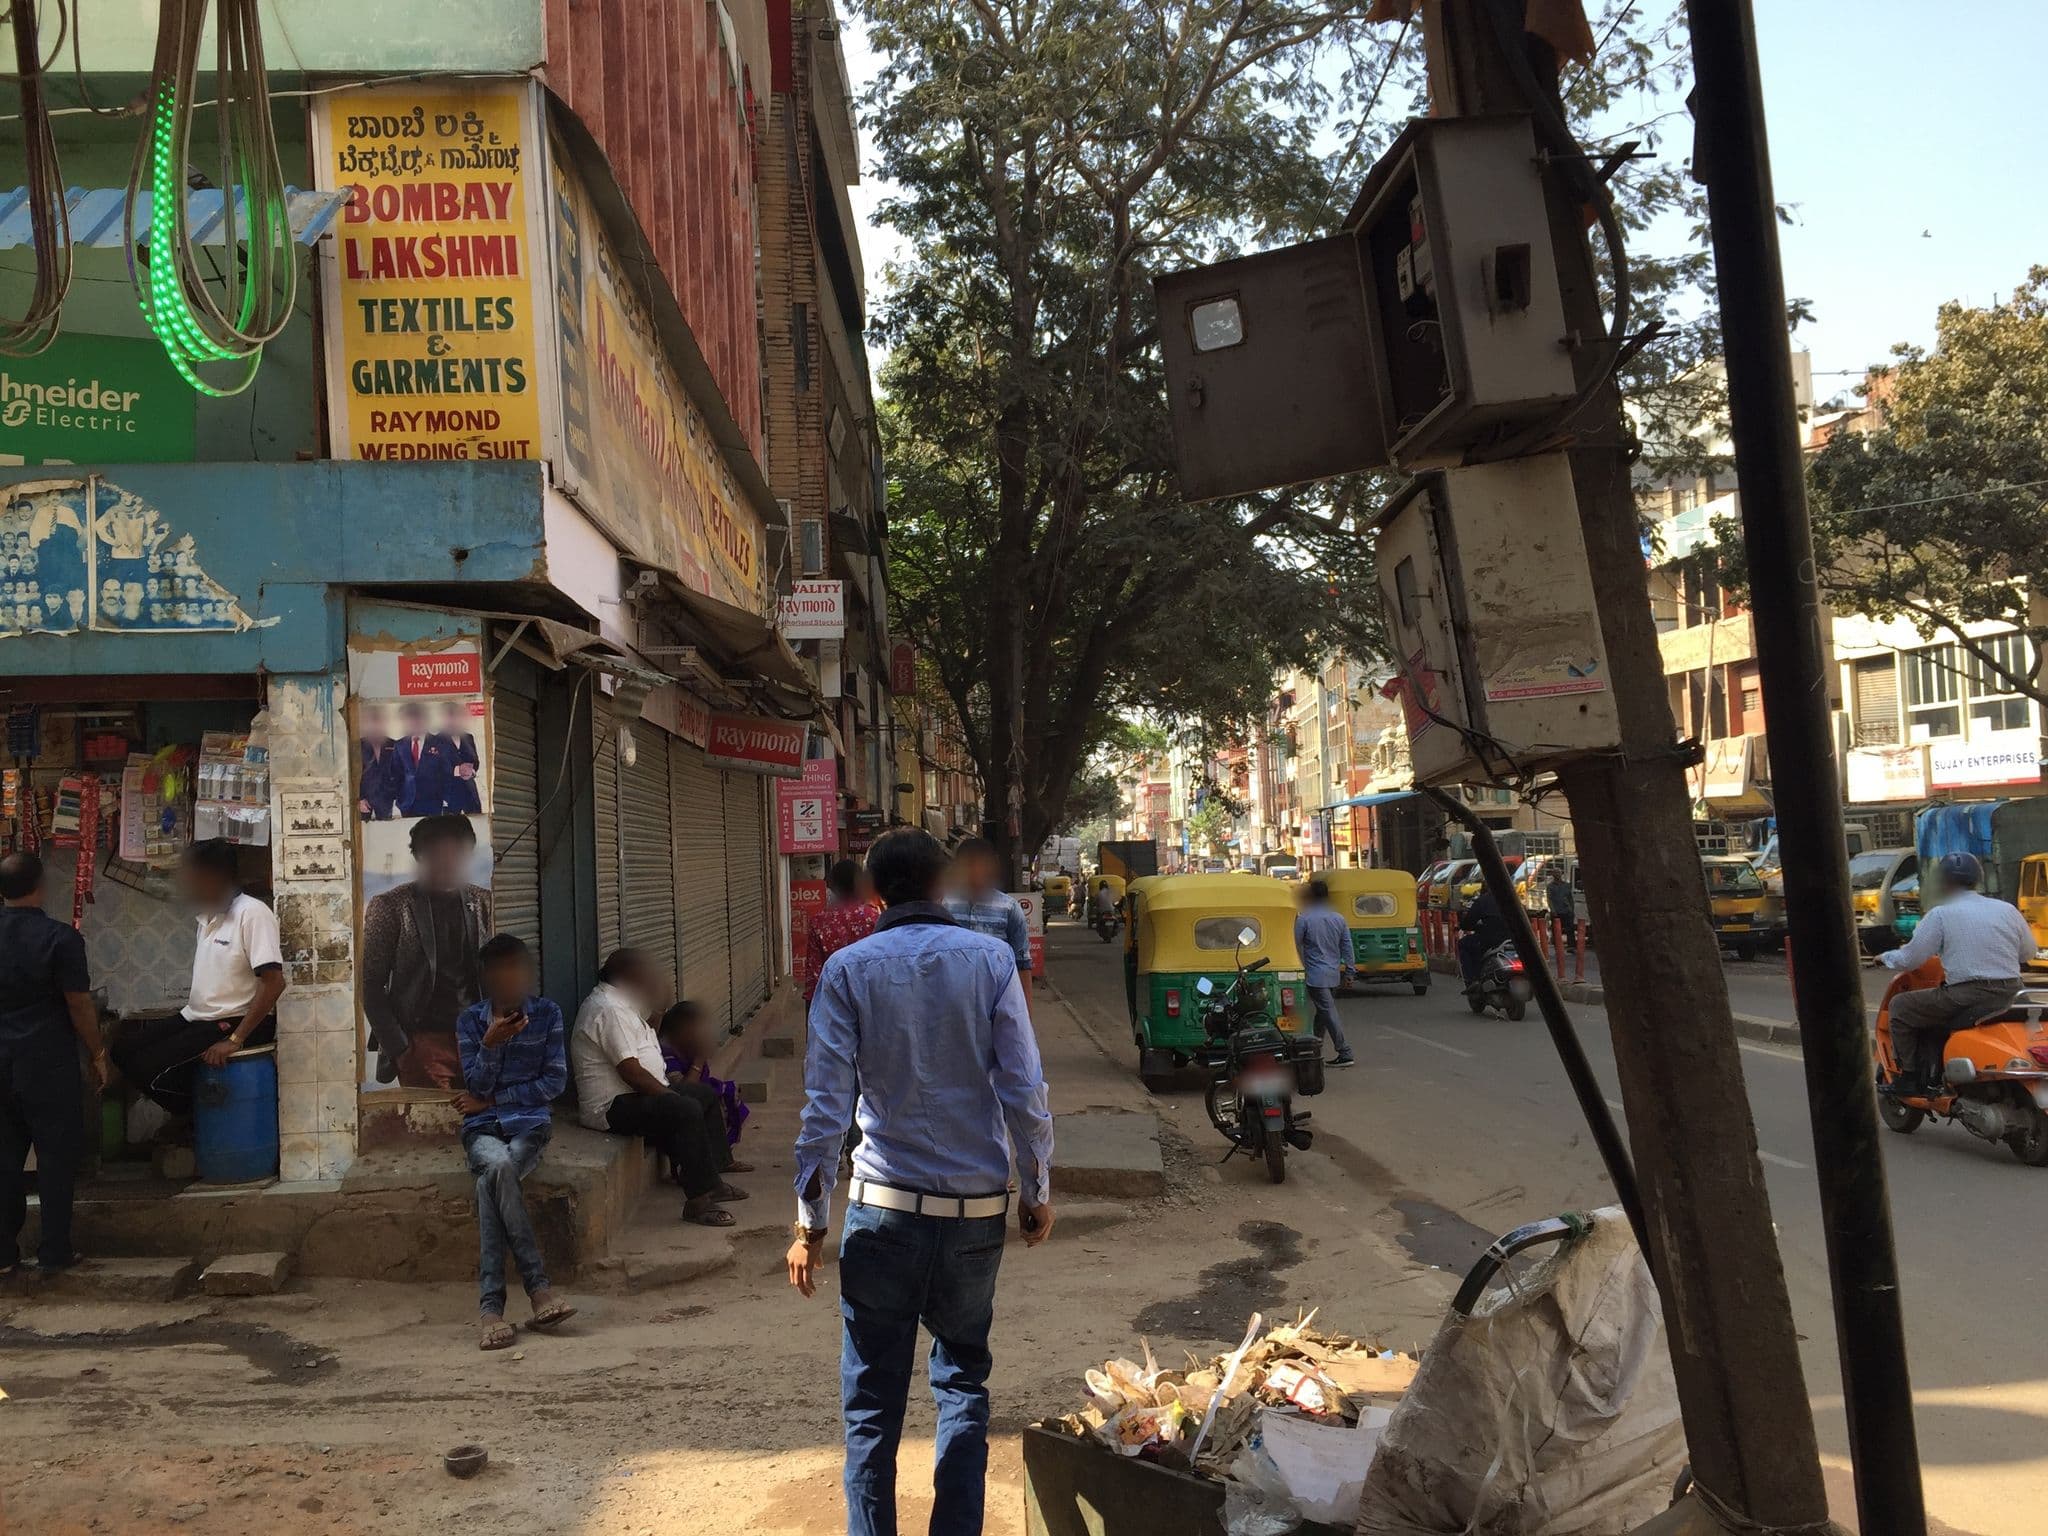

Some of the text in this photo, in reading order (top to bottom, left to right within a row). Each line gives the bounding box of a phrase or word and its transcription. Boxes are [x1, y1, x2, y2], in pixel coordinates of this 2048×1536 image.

[348, 106, 425, 138] ಬಾಂಬೆ
[344, 182, 513, 224] BOMBAY
[345, 233, 518, 279] LAKSHMI
[358, 297, 514, 333] TEXTILES
[427, 335, 451, 356] &
[352, 357, 526, 395] GARMENTS
[1, 372, 140, 412] hneider
[36, 407, 136, 432] Electric
[370, 409, 500, 433] RAYMOND
[358, 440, 530, 461] WEDDING SUIT
[411, 659, 469, 679] Raymond
[433, 680, 474, 688] FABRICS
[716, 725, 800, 754] Raymond
[803, 764, 819, 772] VID
[1935, 752, 2035, 770] SUJAY ENTERPRISES
